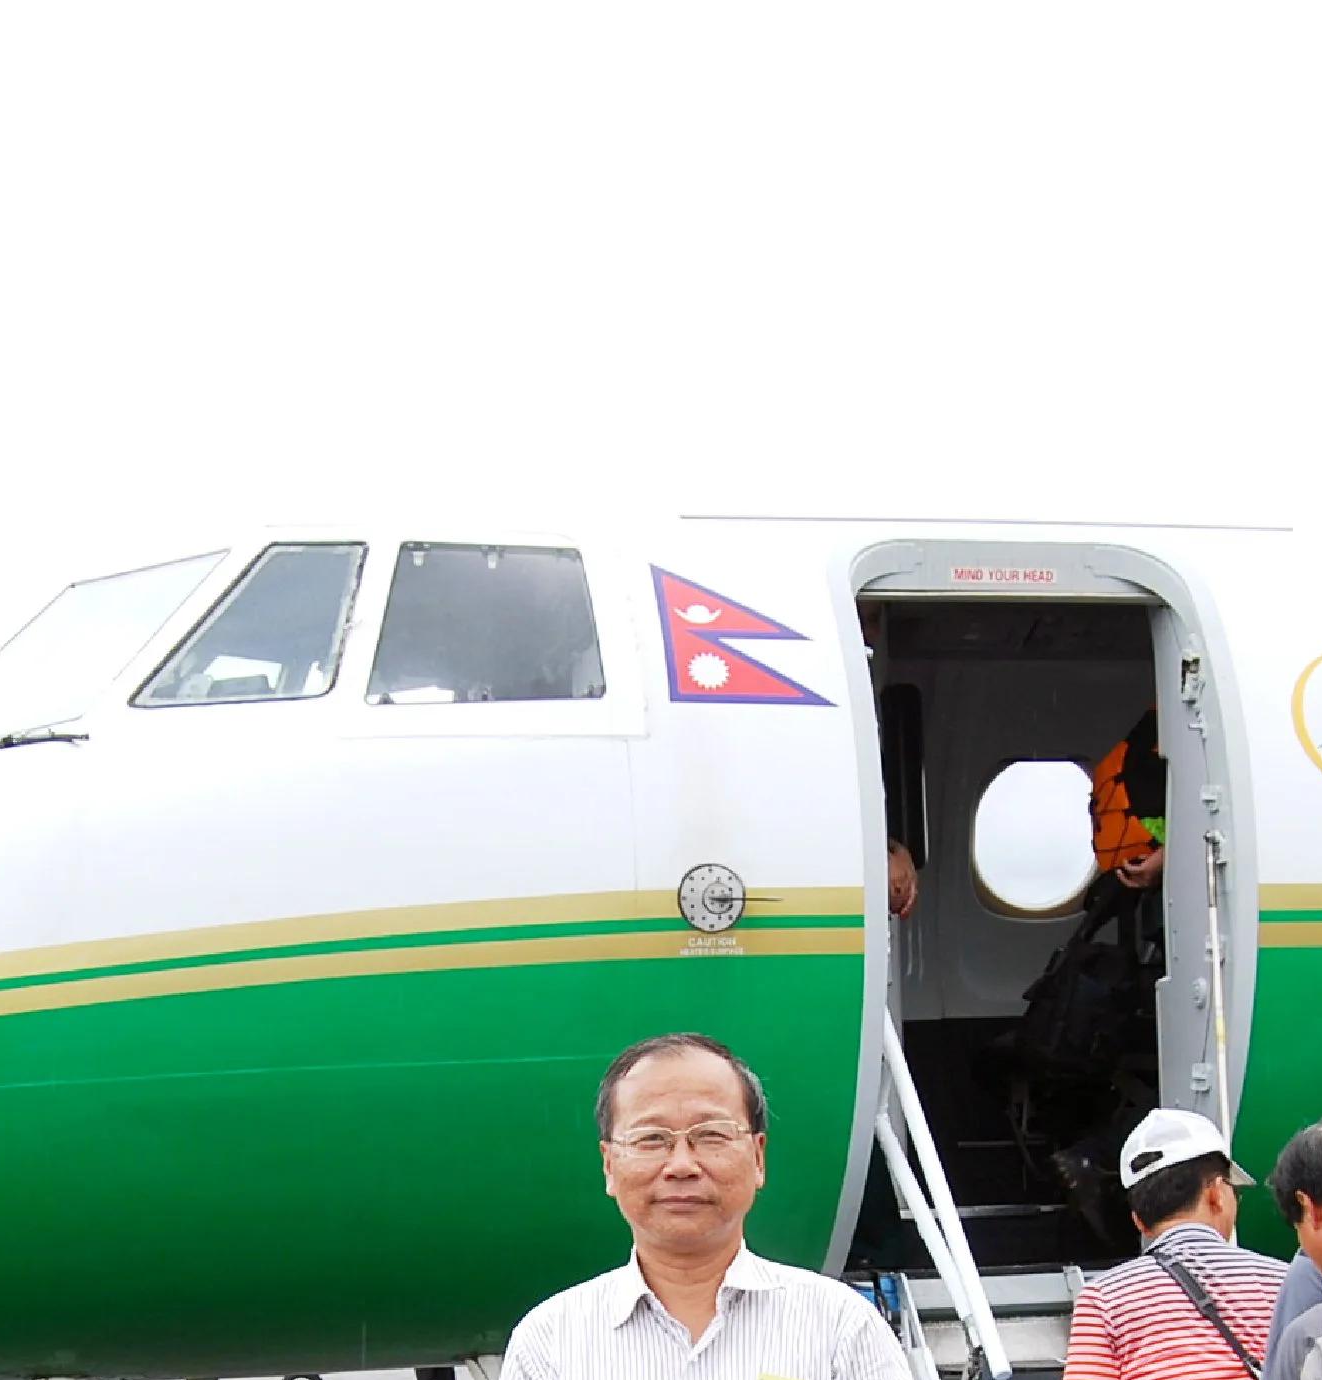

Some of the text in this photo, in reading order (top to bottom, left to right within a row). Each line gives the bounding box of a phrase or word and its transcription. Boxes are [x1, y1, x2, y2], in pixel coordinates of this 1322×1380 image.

[954, 568, 1054, 582] MIND YOUR HEAD
